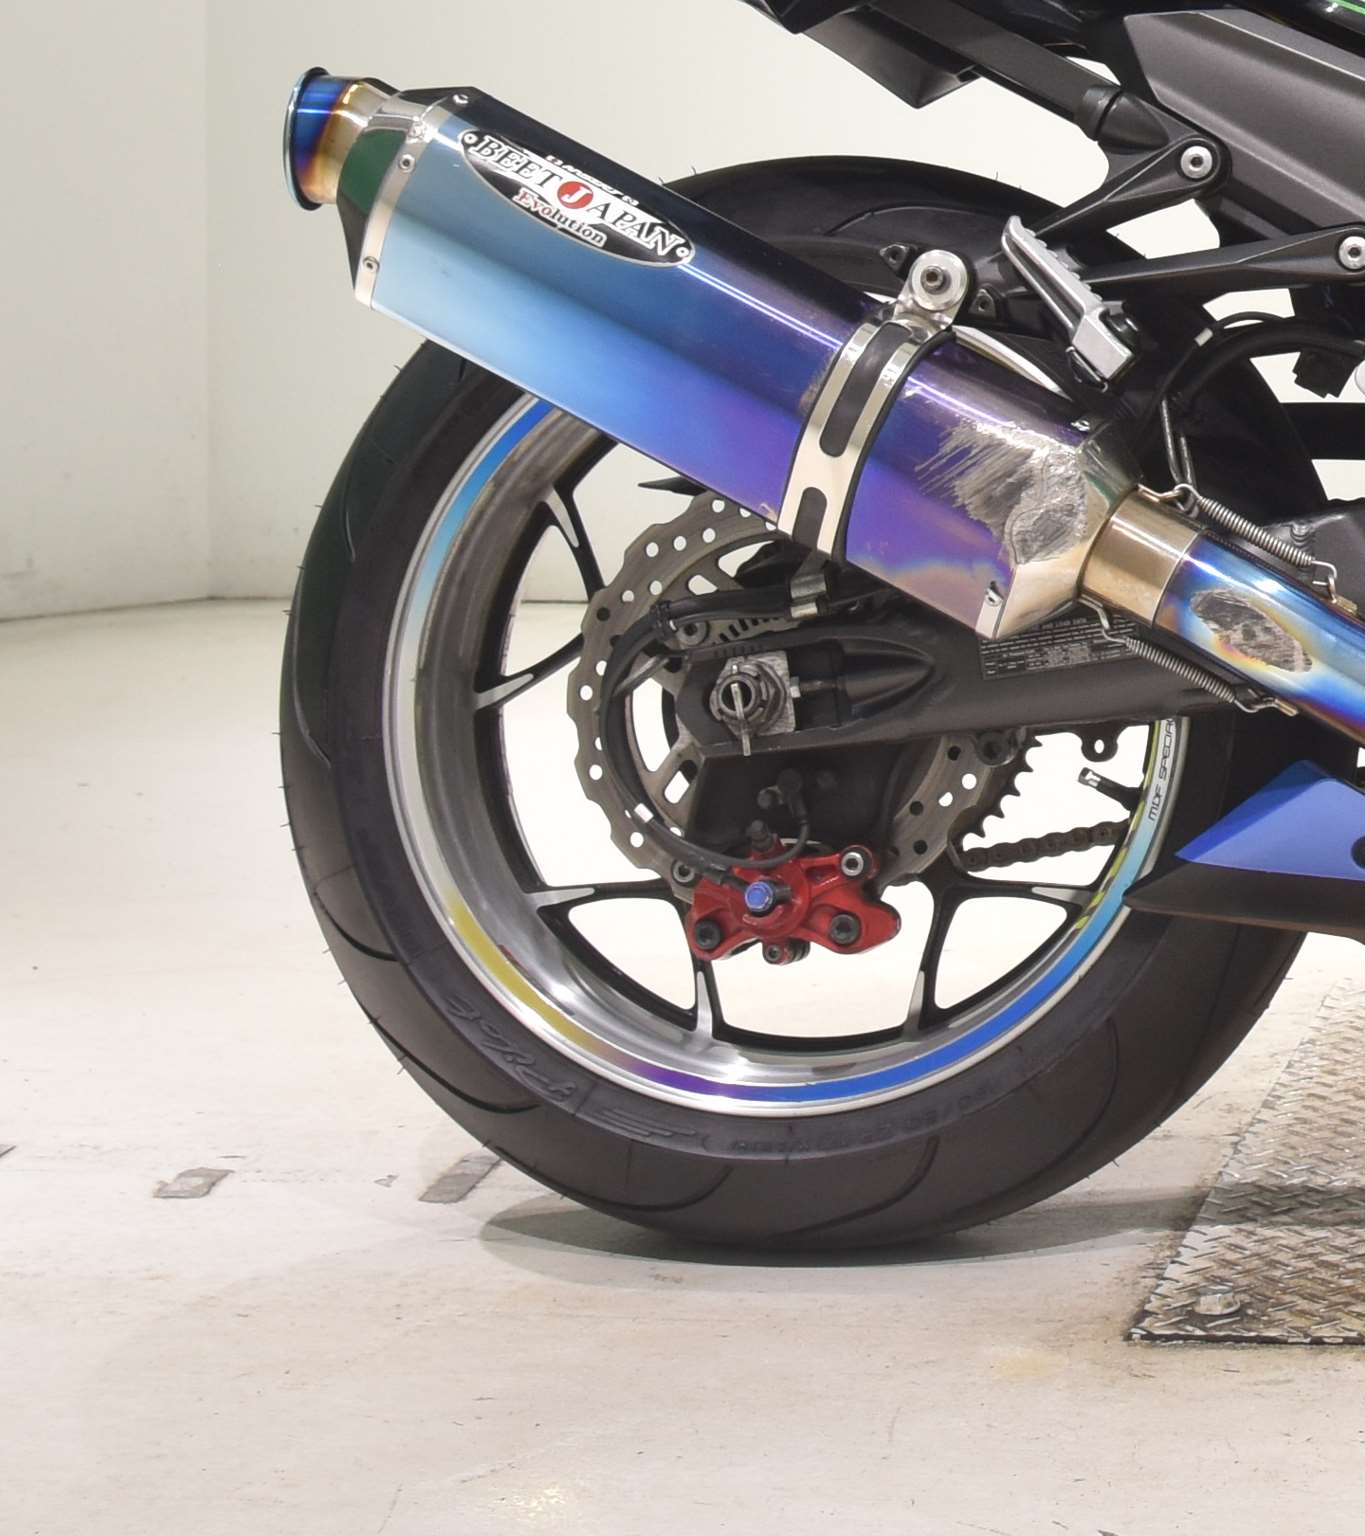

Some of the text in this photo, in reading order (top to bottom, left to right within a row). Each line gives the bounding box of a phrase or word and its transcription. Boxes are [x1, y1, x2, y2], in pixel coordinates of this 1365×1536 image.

[469, 135, 563, 189] BEET
[557, 180, 685, 257] JAPAN
[512, 187, 607, 247] Evolution
